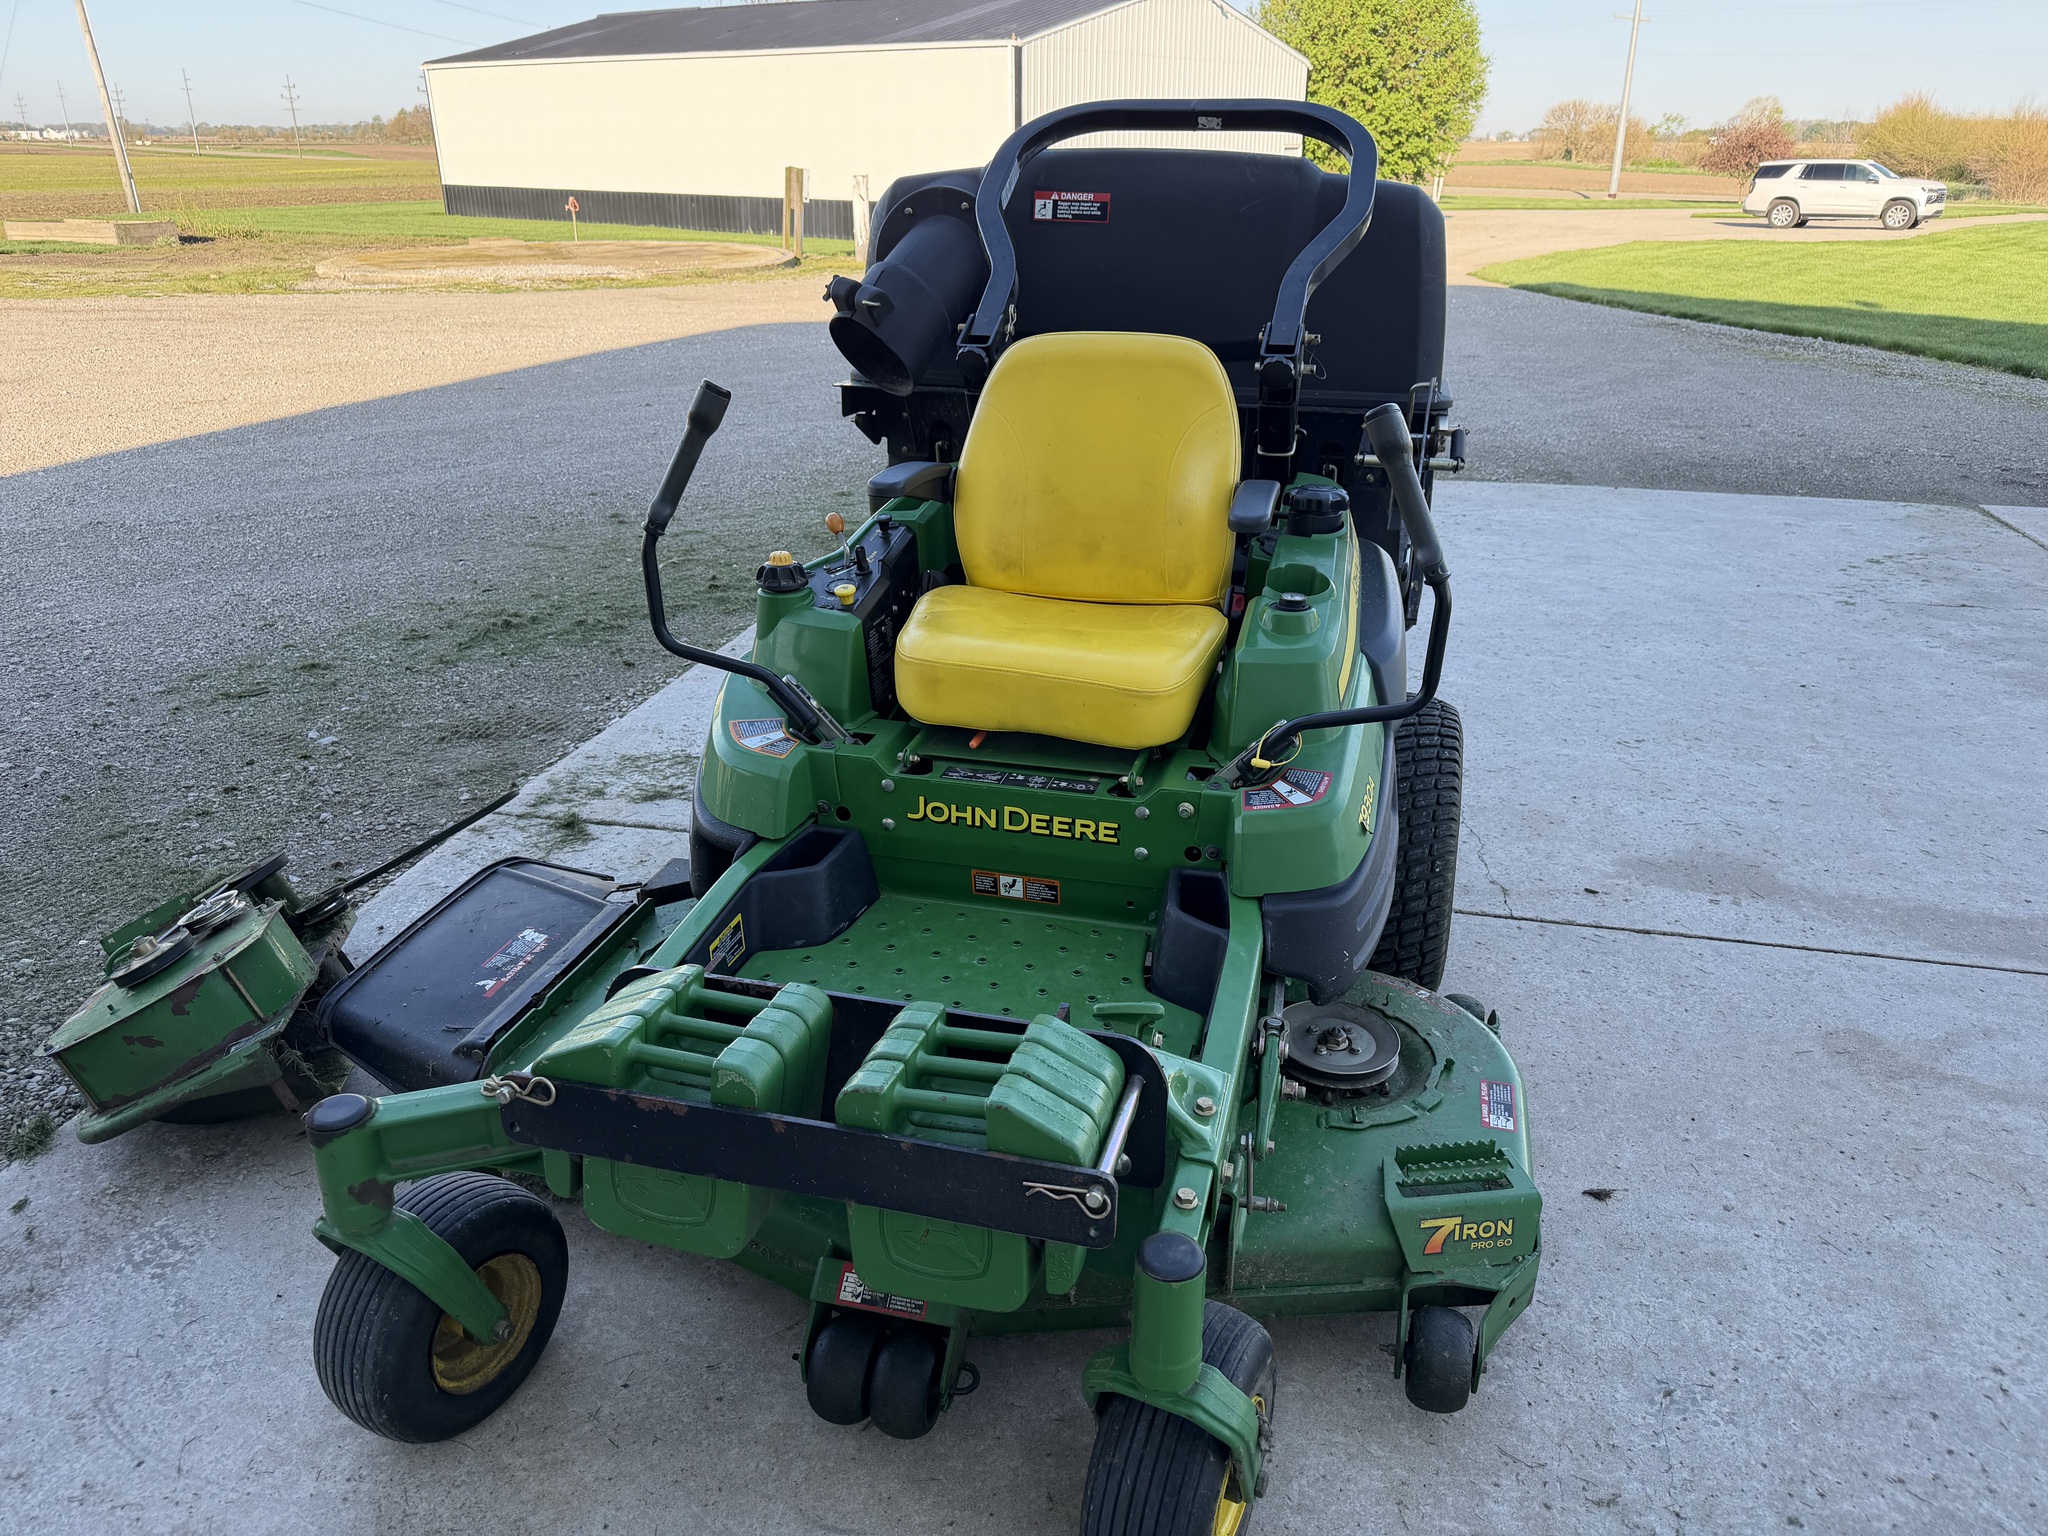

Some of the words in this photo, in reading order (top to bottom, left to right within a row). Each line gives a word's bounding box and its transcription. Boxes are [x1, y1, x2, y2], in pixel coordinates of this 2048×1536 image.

[1061, 192, 1094, 200] DANGER
[907, 796, 998, 829] JOHN
[1003, 805, 1120, 843] DEERE
[1470, 1240, 1494, 1251] PRO
[1497, 1238, 1513, 1248] 60
